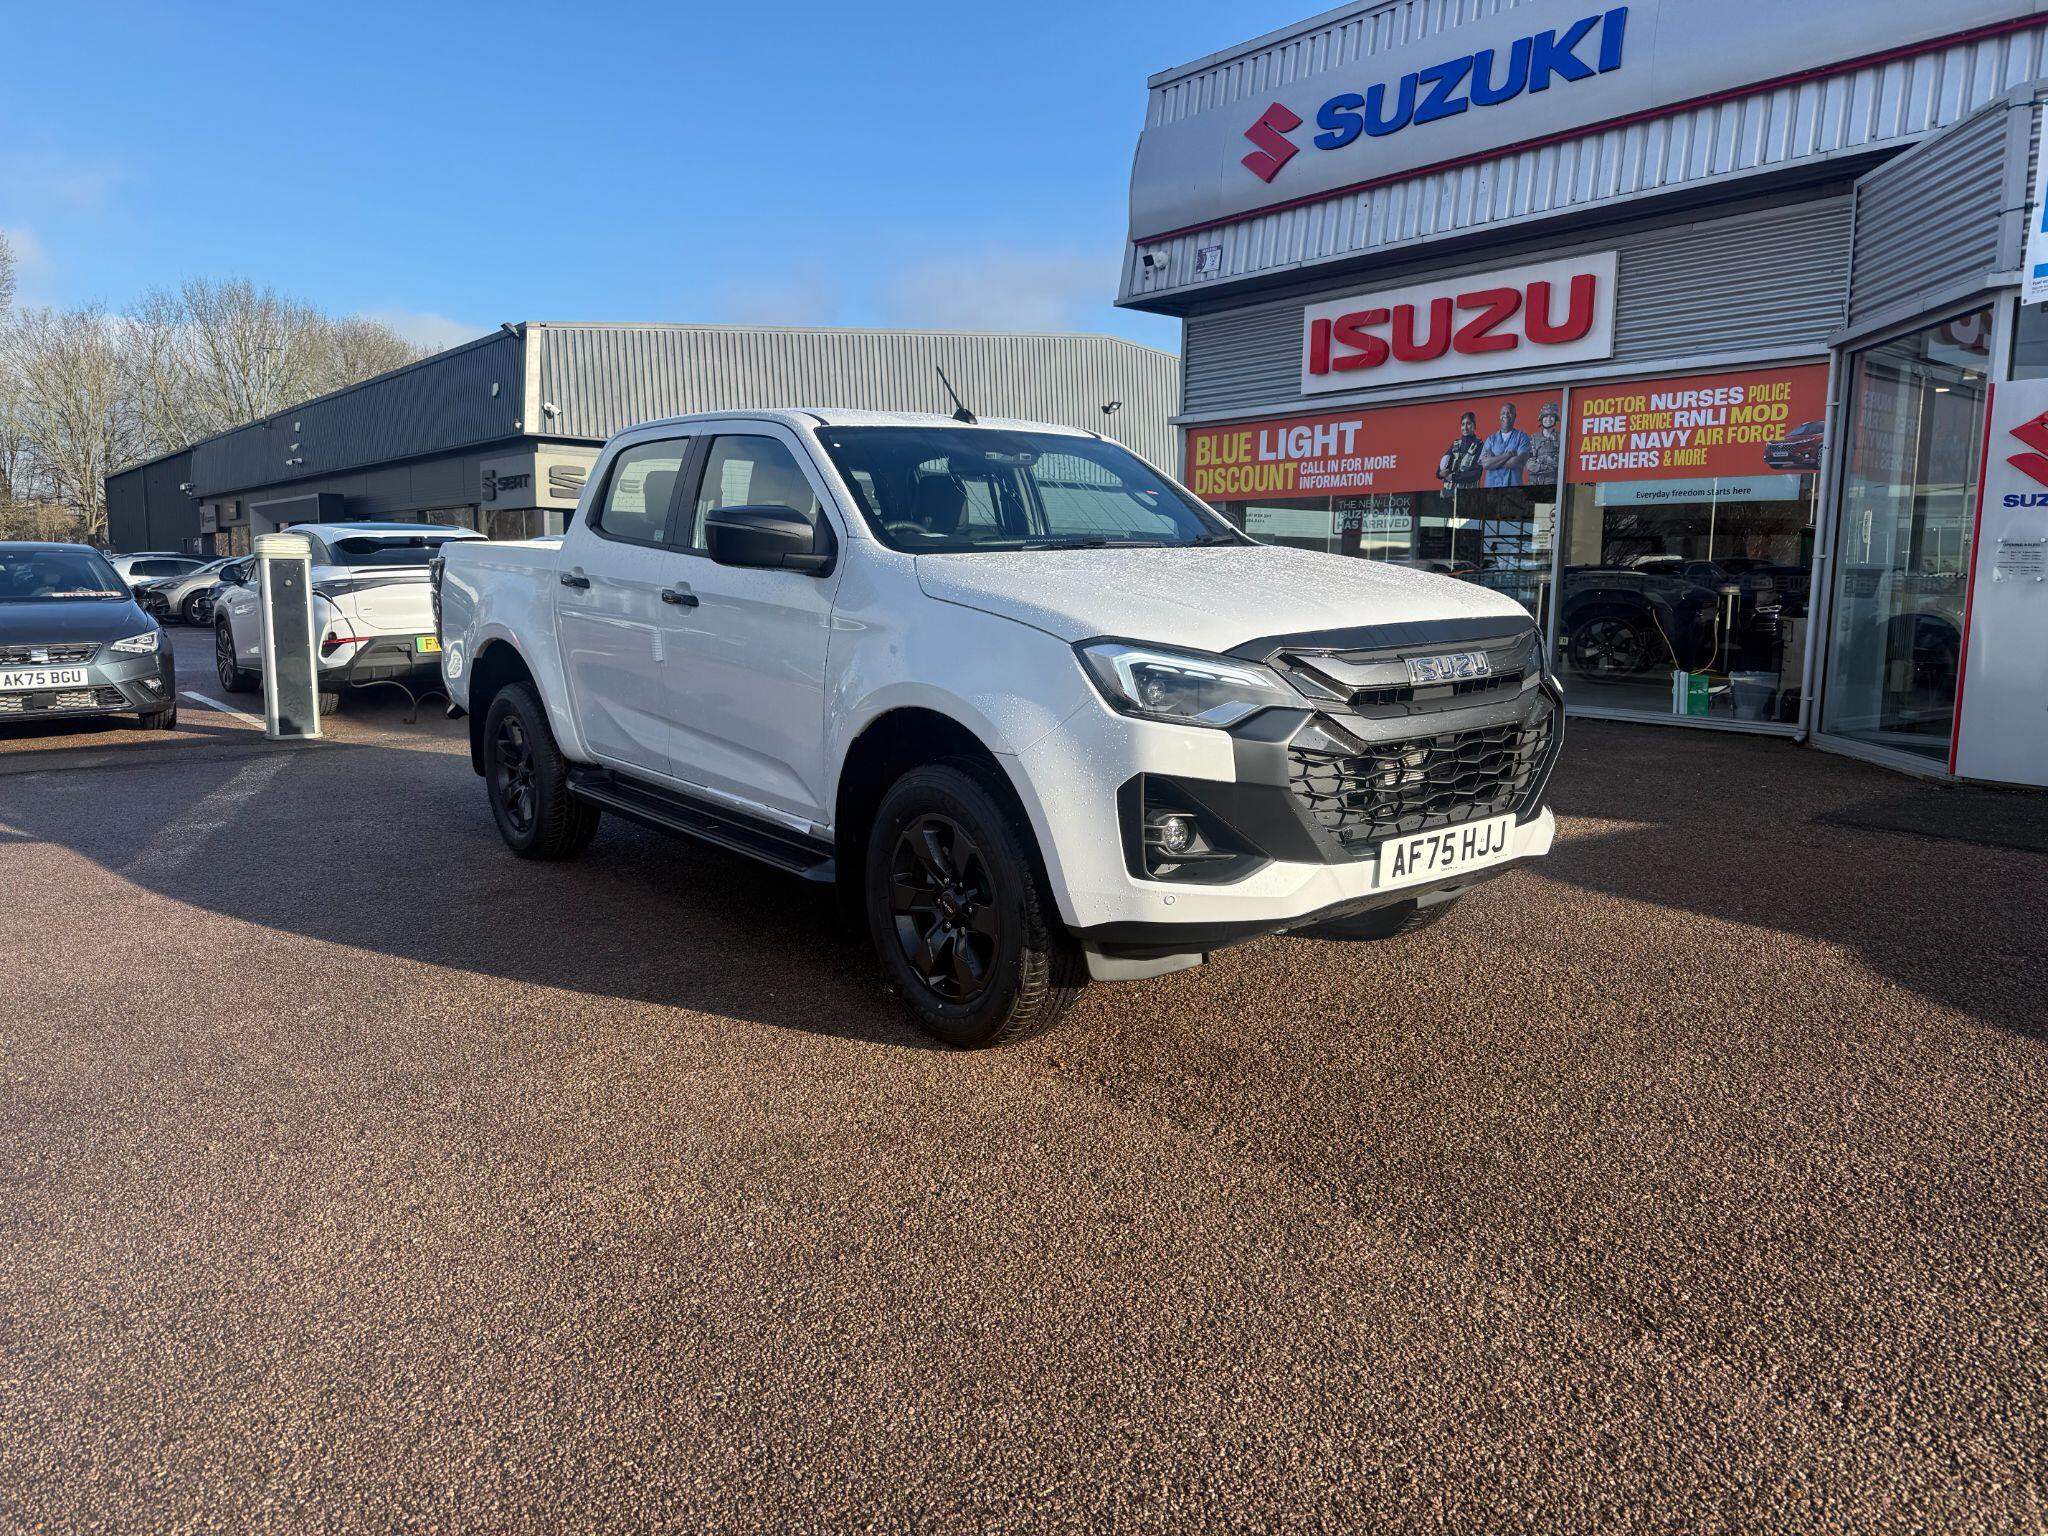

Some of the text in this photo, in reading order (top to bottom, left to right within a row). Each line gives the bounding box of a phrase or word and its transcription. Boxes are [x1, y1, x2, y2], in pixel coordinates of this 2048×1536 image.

[1313, 6, 1628, 150] SUZUKI
[1309, 273, 1596, 375] ISUZU
[1583, 381, 1792, 417] DOCTOR NURSES POLICE
[1582, 403, 1789, 435] FIRE SERVICE RNLI MOD
[1195, 420, 1363, 466] BLUE LIGHT
[1580, 423, 1787, 453] ARMY NAVY AIR FORCE
[1300, 455, 1397, 475] CALL IN FOR MORE
[1580, 448, 1708, 471] TEACHERS & MORE
[497, 473, 531, 492] SEAT
[1194, 462, 1298, 495] DISCOUNT
[1299, 472, 1373, 490] INFORMATION
[1338, 500, 1356, 510] THE
[1636, 487, 1752, 500] Everyday freedom starts here
[1336, 518, 1410, 530] HAS ARRIVED
[1338, 507, 1410, 520] ISUZU D-MAX
[3, 670, 82, 687] AK75 BGU
[1408, 653, 1490, 683] ISUZU
[1391, 820, 1507, 878] AF75 HJJ
